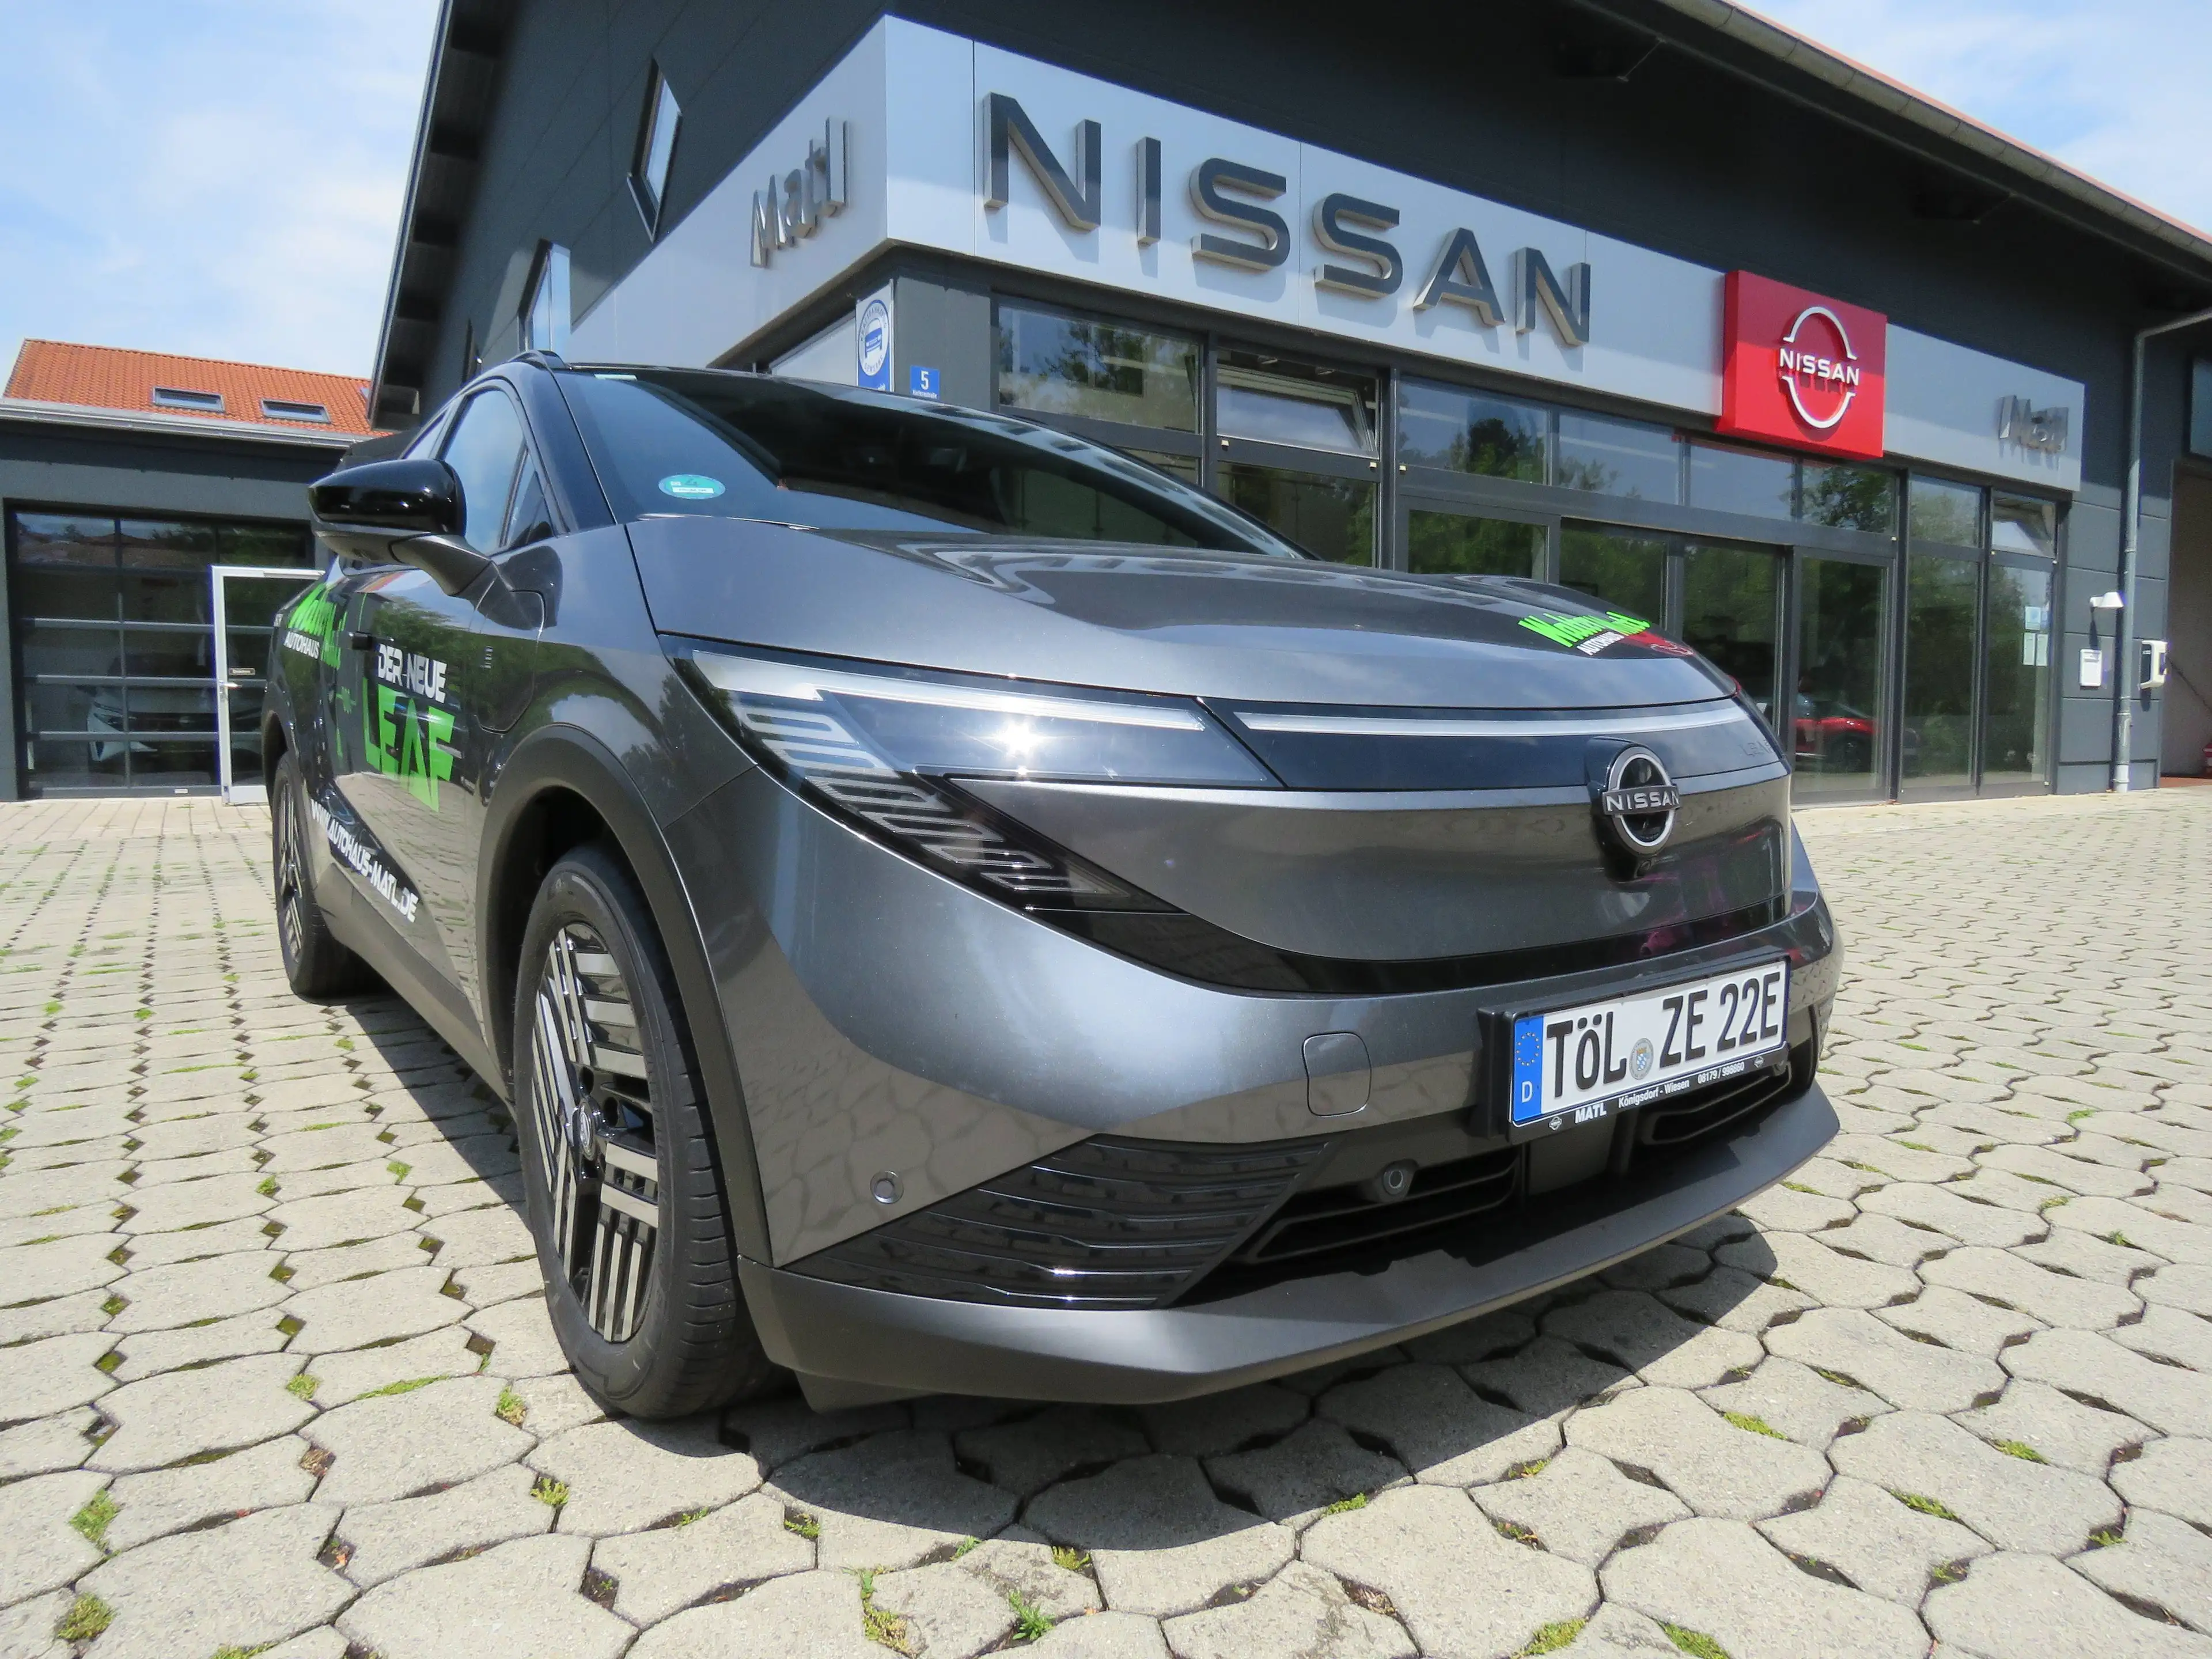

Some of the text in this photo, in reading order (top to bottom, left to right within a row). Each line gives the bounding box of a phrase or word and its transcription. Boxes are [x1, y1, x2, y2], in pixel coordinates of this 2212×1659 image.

[983, 92, 1590, 347] NISSAN
[921, 370, 929, 390] 5
[1779, 348, 1859, 386] NISSAN
[284, 631, 320, 659] AUTOHAUS
[1577, 631, 1625, 656] AUTOHAUS
[378, 643, 447, 703] DER NEUE
[362, 678, 455, 812] LEAF
[1606, 790, 1680, 812] NISSAN
[1547, 972, 1781, 1099] TÖL ZE 22E
[1521, 1081, 1532, 1103] D
[1575, 1102, 1607, 1123] MATL
[1618, 1086, 1659, 1108] Königsdorf
[1665, 1079, 1690, 1095] Wiesen
[1698, 1070, 1717, 1084] 08179
